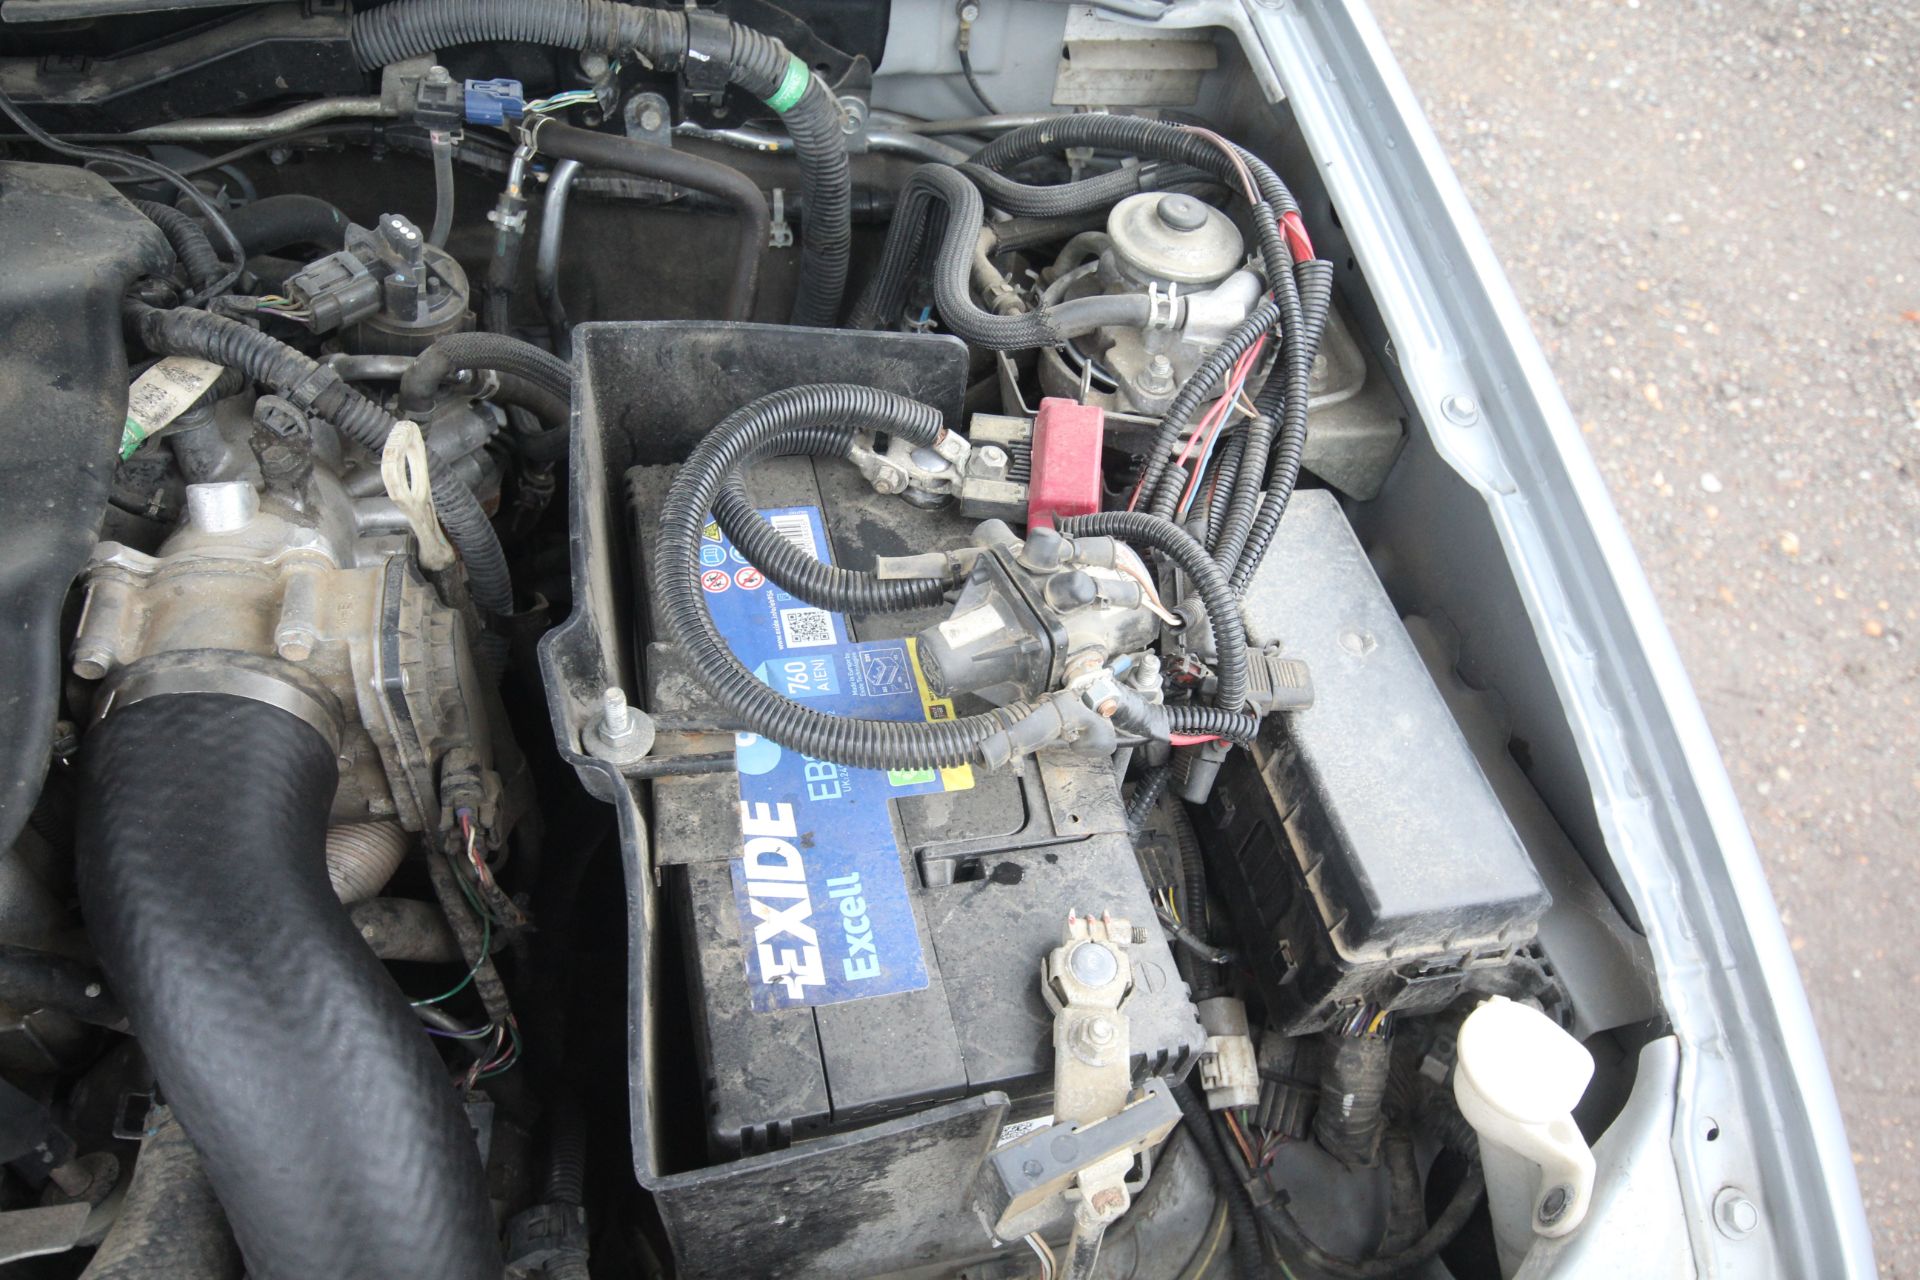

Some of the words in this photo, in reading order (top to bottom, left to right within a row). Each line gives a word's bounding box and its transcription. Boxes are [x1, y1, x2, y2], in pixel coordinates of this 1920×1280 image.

[784, 661, 811, 695] 760
[800, 753, 842, 801] EB
[740, 800, 826, 1000] EXIDE
[826, 871, 881, 981] Excell
